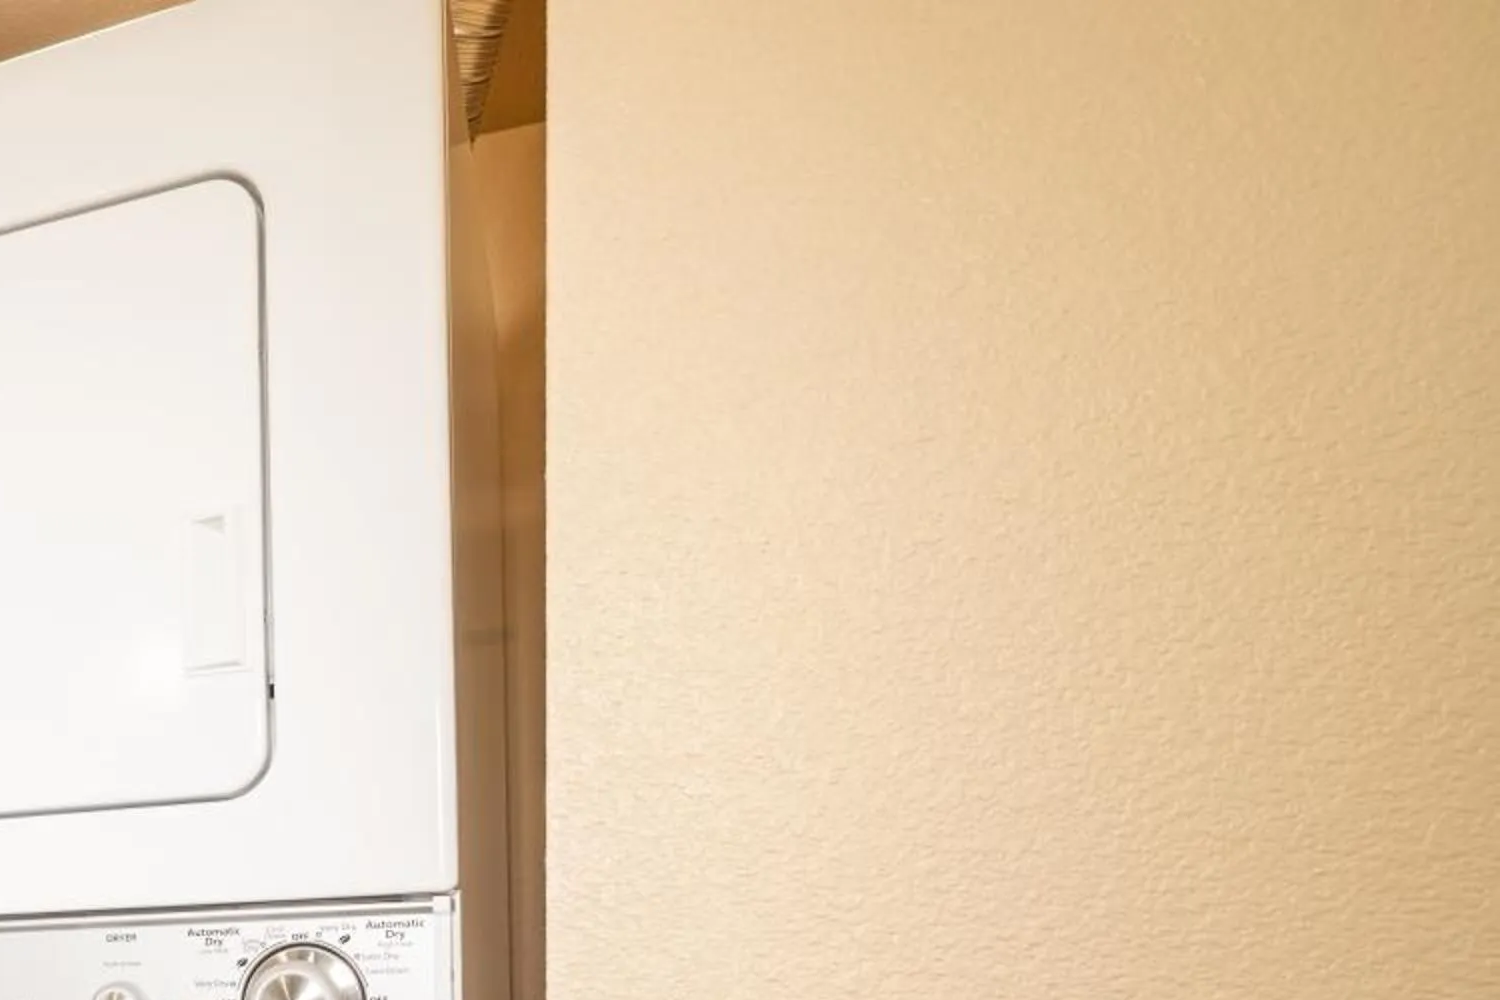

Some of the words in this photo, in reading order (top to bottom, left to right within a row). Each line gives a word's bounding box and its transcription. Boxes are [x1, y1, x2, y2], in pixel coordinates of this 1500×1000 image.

[366, 919, 425, 930] Automatic
[187, 927, 240, 938] Automatic
[385, 929, 405, 941] Dry
